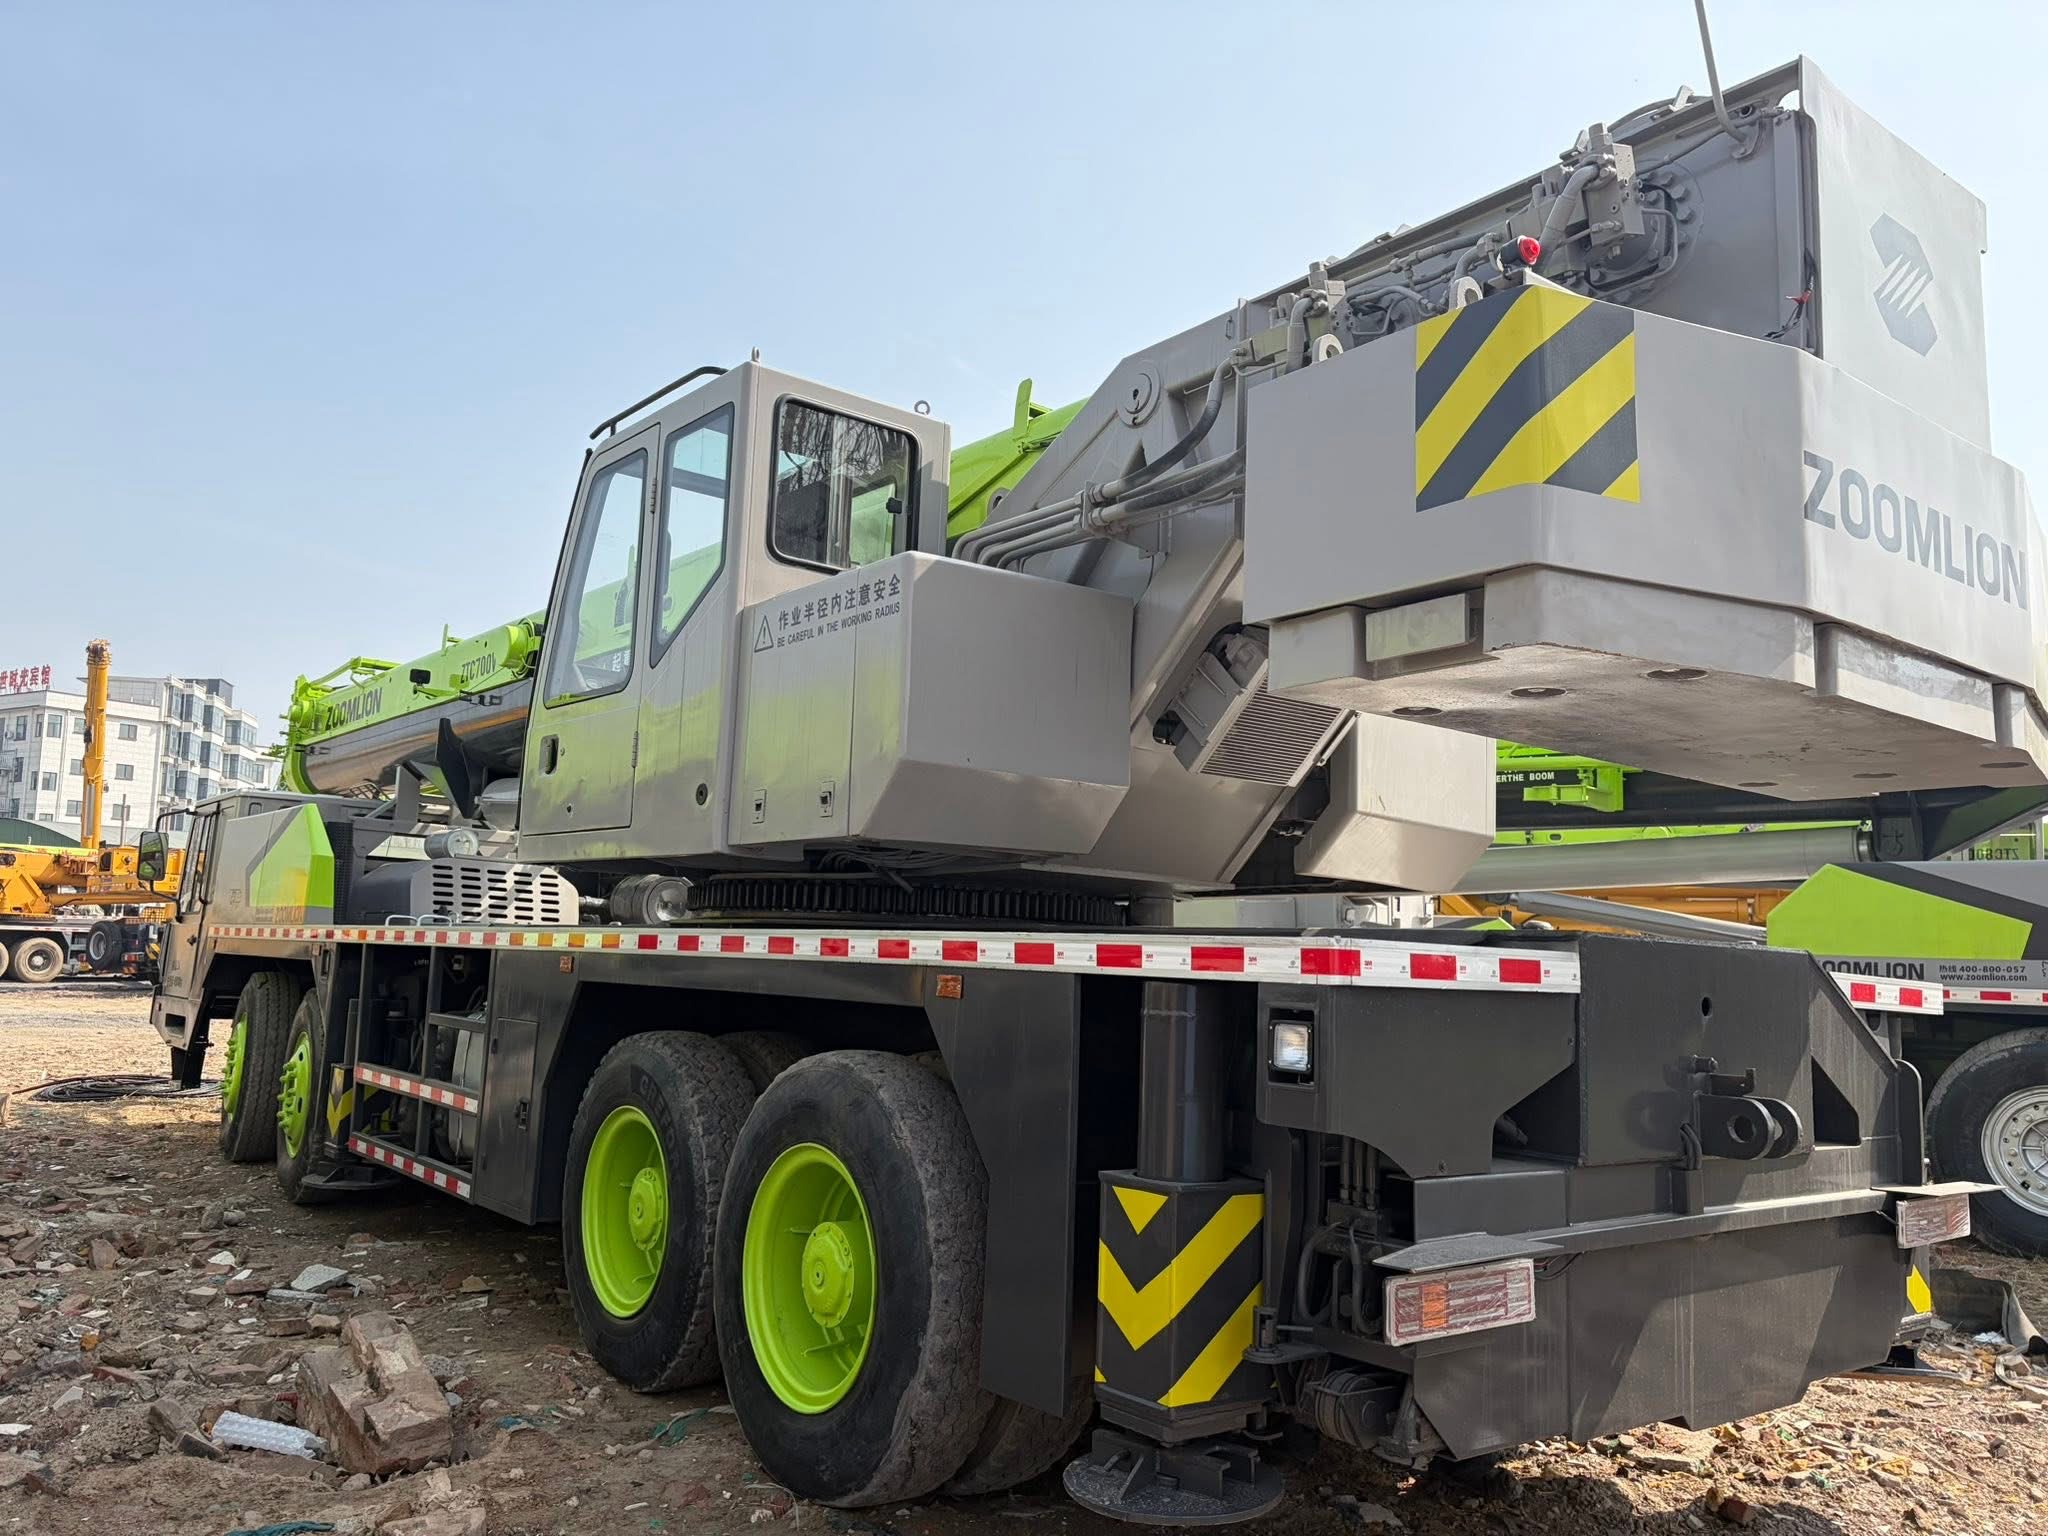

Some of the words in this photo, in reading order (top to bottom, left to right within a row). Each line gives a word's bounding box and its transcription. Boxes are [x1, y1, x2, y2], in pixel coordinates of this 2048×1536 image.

[1803, 449, 2029, 611] ZOOMLION
[778, 573, 901, 631] 作业半径内注意安全
[777, 637, 785, 648] BE
[787, 628, 814, 645] CAREFUL
[817, 624, 824, 636] IN
[826, 620, 839, 633] THE
[841, 610, 872, 629] WORKING
[874, 602, 901, 620] RADIUS
[325, 687, 383, 731] ZOOMLION
[1496, 774, 1524, 782] ERTHE
[1529, 772, 1554, 781] BOOM
[1818, 960, 1925, 980] OOMLION
[1940, 973, 2028, 981] www.zoomlion.com
